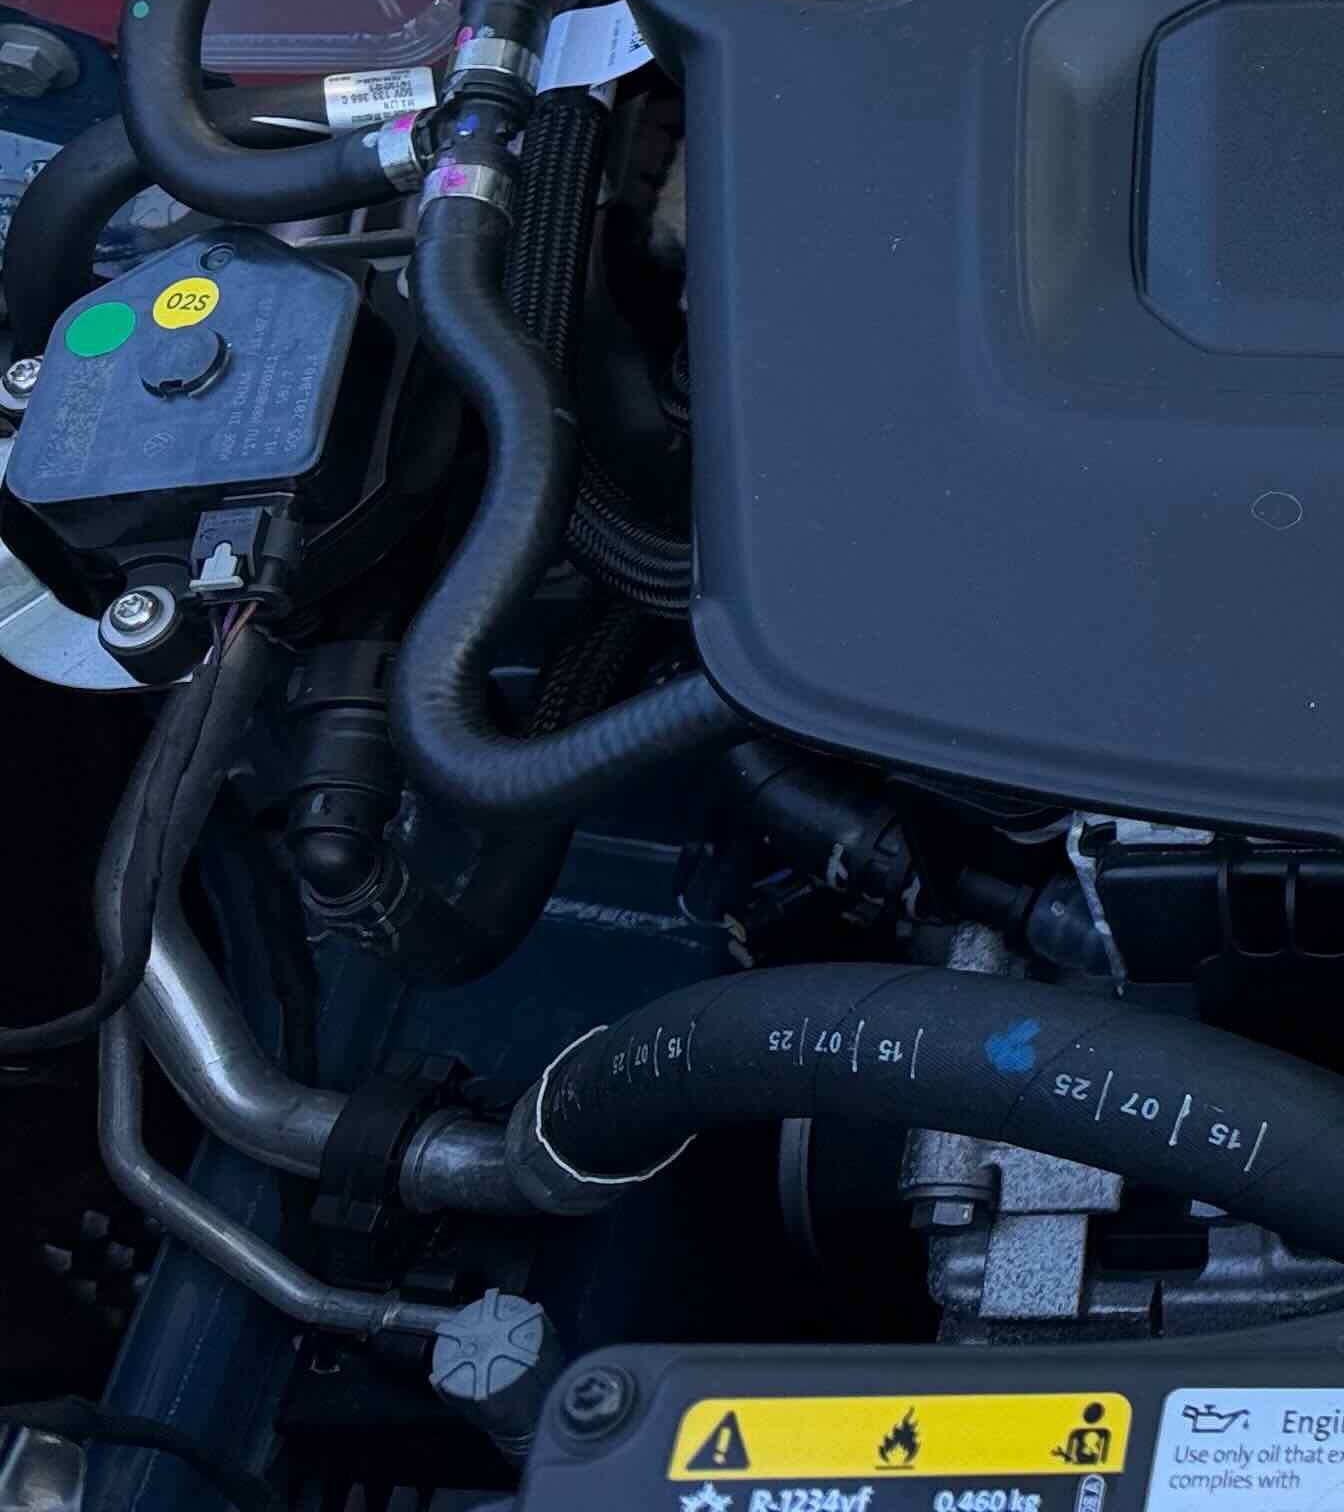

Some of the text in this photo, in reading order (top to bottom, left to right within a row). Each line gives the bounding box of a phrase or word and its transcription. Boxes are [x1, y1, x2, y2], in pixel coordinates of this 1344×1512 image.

[768, 1029, 793, 1052] 25
[878, 1038, 903, 1063] 15
[1054, 1072, 1242, 1152] 15 07 25
[1174, 1444, 1210, 1465] Use
[1213, 1444, 1254, 1469] only
[1257, 1444, 1281, 1465] oil
[1284, 1445, 1323, 1465] that
[1168, 1469, 1302, 1494] complies with
[1008, 1488, 1043, 1512] kg
